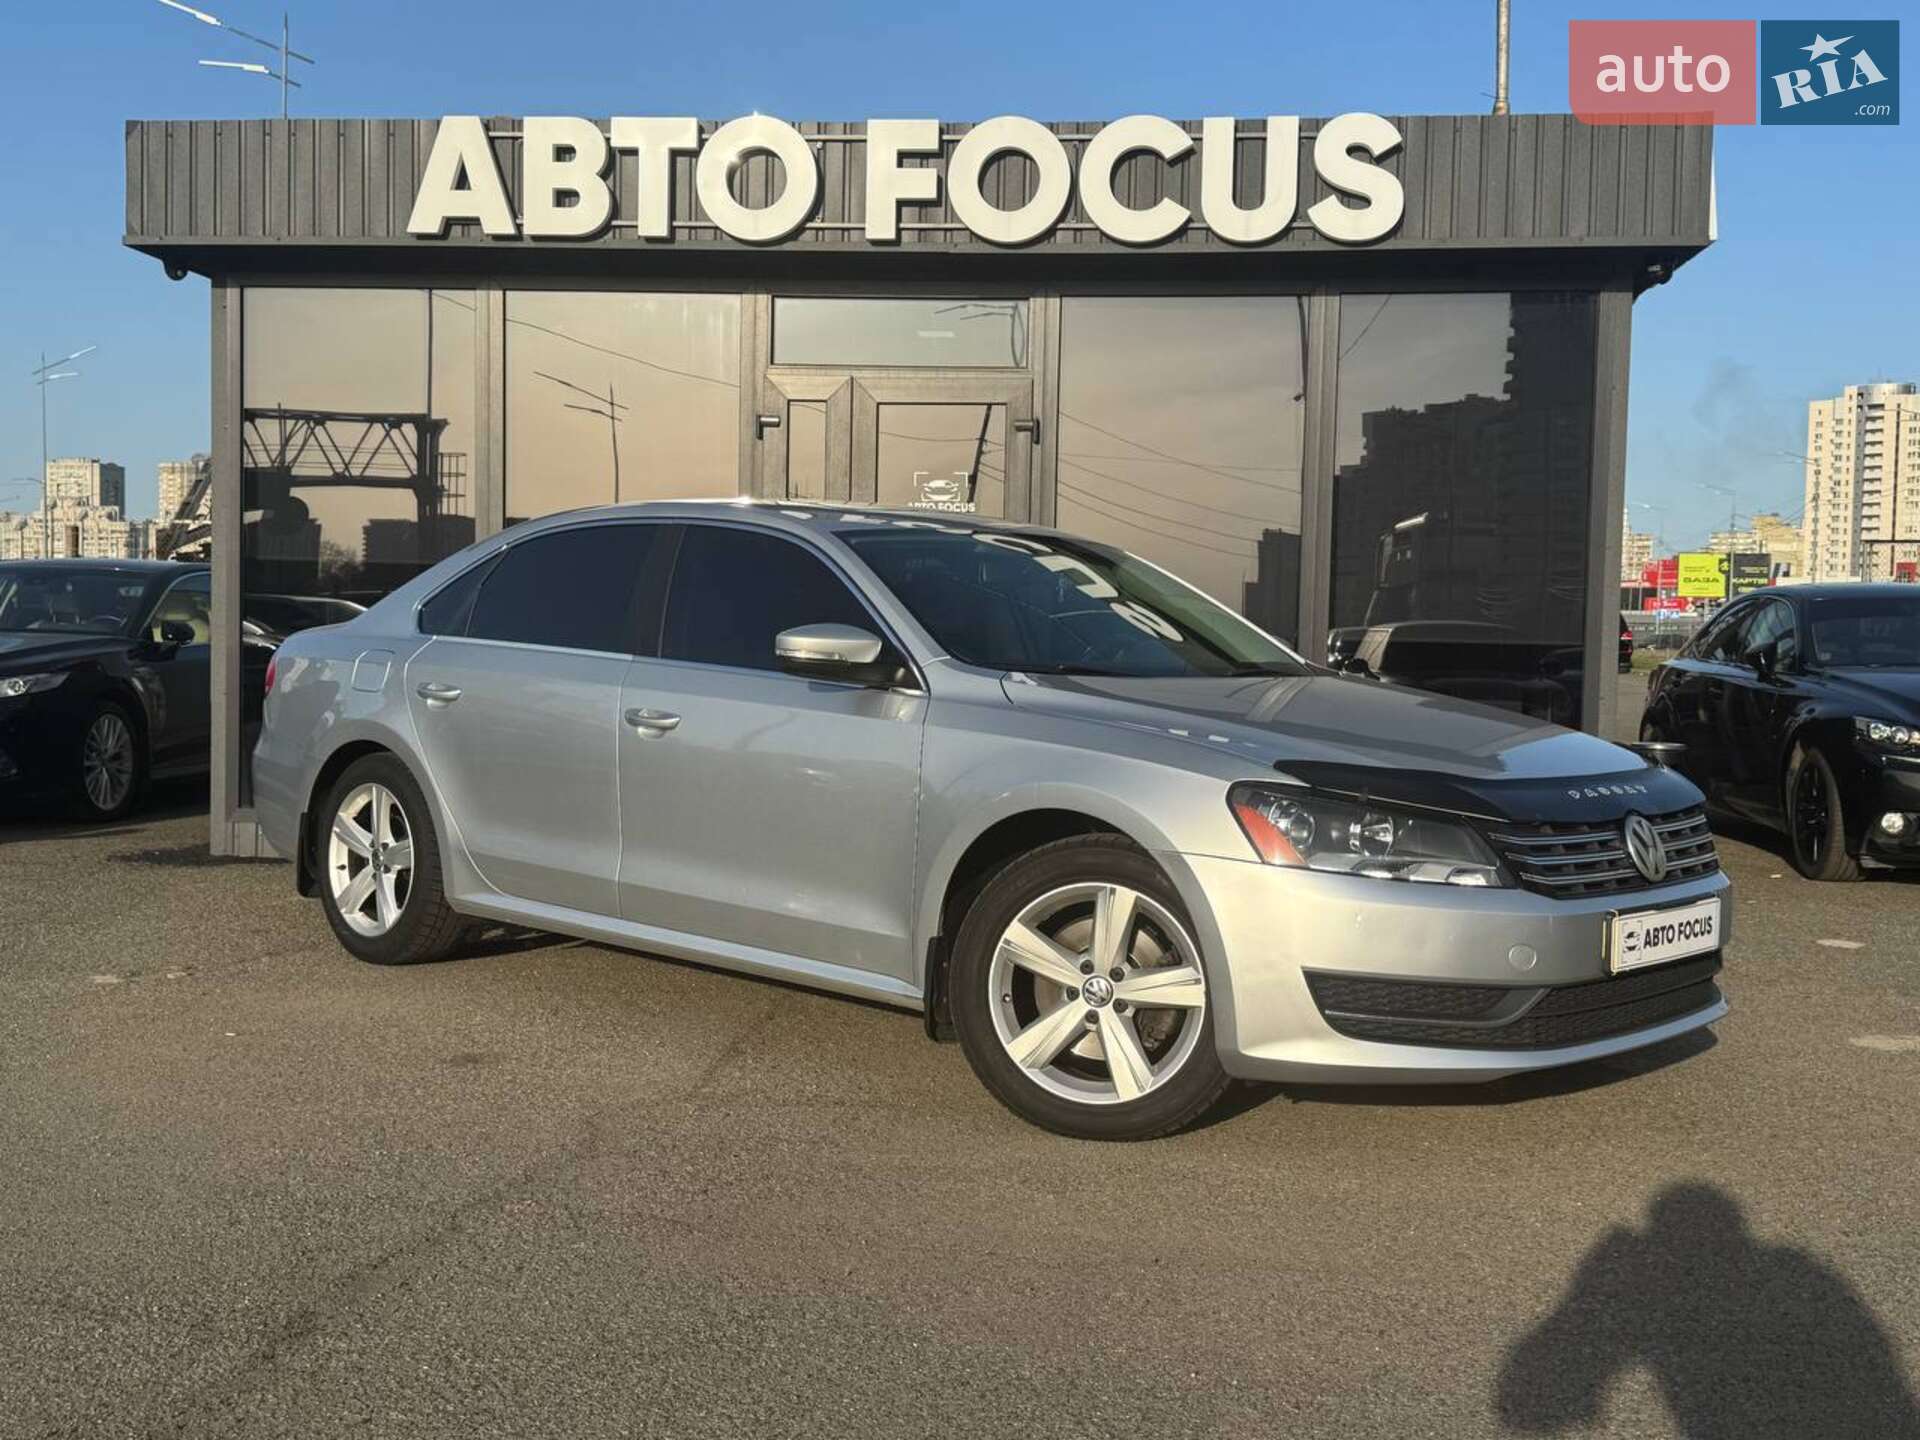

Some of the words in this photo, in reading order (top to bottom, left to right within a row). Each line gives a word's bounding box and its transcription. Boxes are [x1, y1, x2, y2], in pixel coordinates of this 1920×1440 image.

[407, 113, 818, 243] АВТО
[866, 112, 1404, 244] FOCUS
[937, 502, 976, 513] FOCUS
[1643, 924, 1676, 950] АВТО
[1678, 915, 1713, 942] FOCUS
